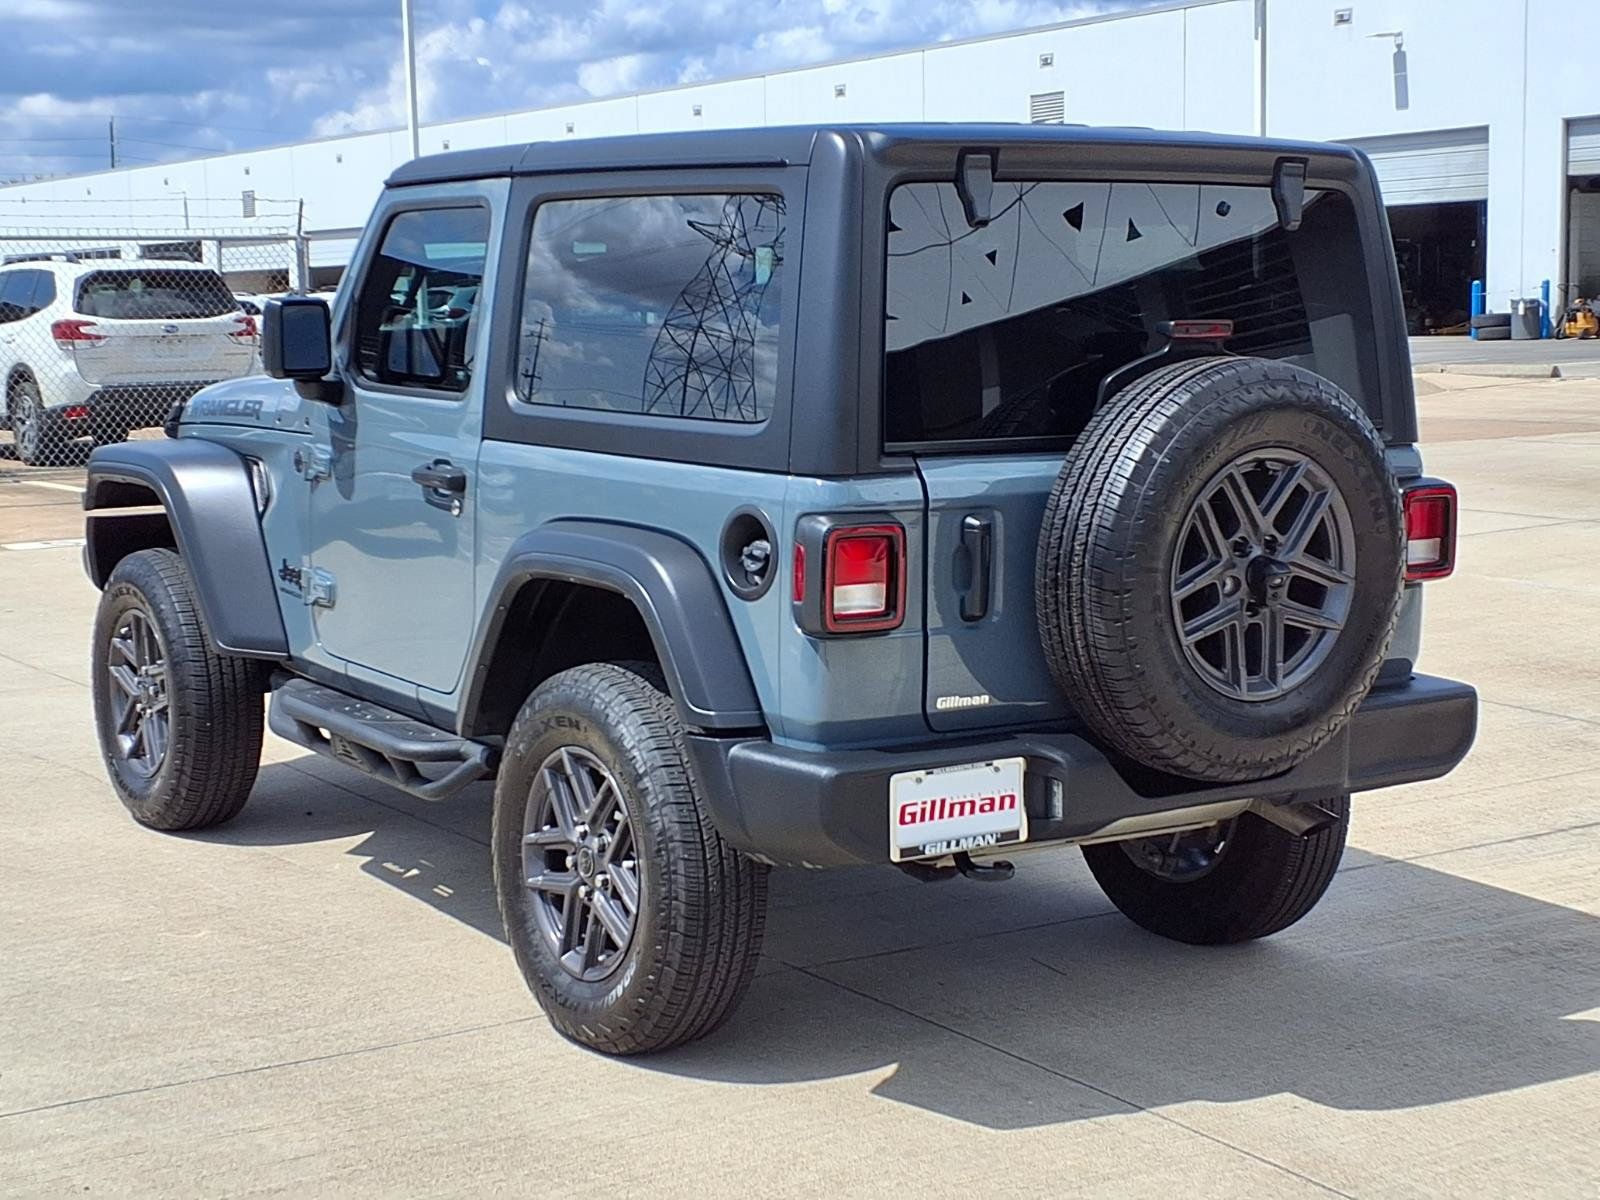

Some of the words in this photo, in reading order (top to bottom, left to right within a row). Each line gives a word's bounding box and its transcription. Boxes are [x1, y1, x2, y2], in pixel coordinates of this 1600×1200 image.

[936, 694, 990, 710] Gillman
[898, 793, 1017, 826] Gillman
[924, 832, 997, 855] GILLMAN
